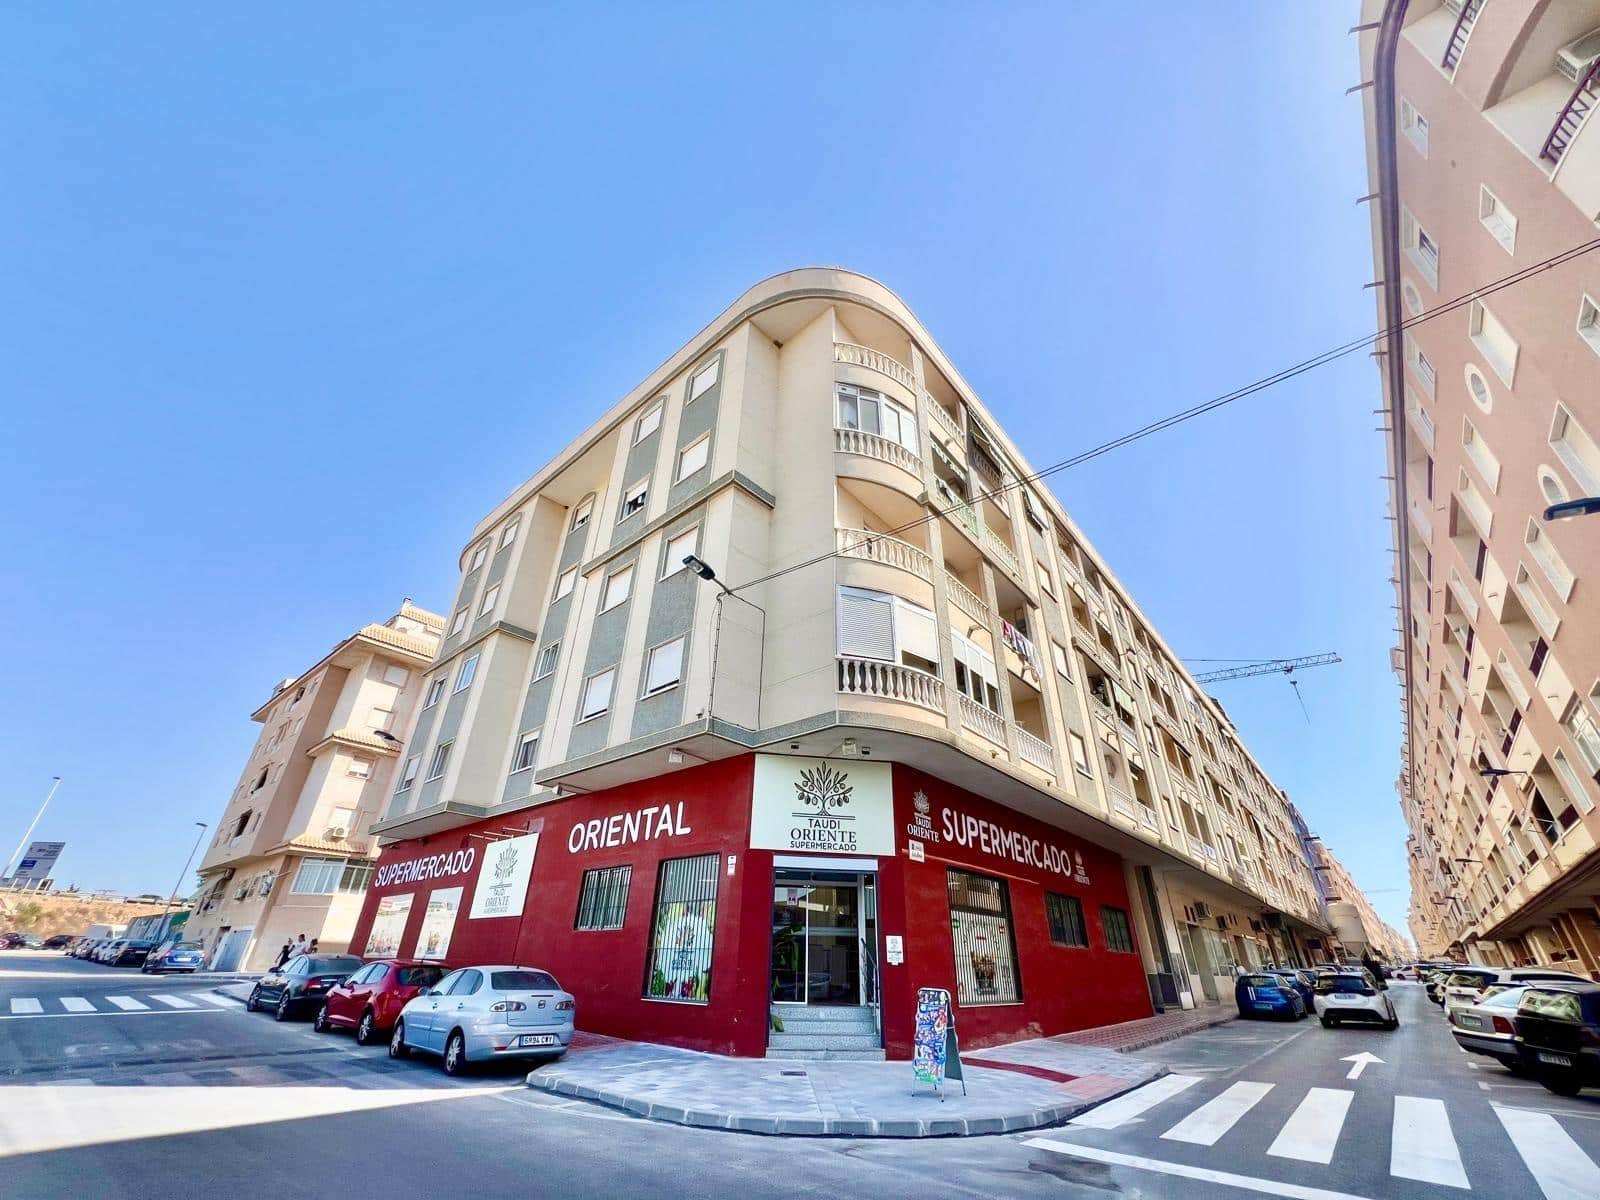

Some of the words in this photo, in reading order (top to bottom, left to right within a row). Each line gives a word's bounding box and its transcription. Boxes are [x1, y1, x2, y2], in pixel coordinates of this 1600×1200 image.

[568, 801, 691, 853] ORIENTAL
[808, 818, 840, 830] TAUDI
[907, 823, 940, 843] ORIENTE
[790, 827, 857, 843] ORIENTE
[942, 807, 1071, 877] SUPERMERCADO
[790, 840, 857, 851] SUPERMERCADO
[375, 848, 475, 887] SUPERMERCADO
